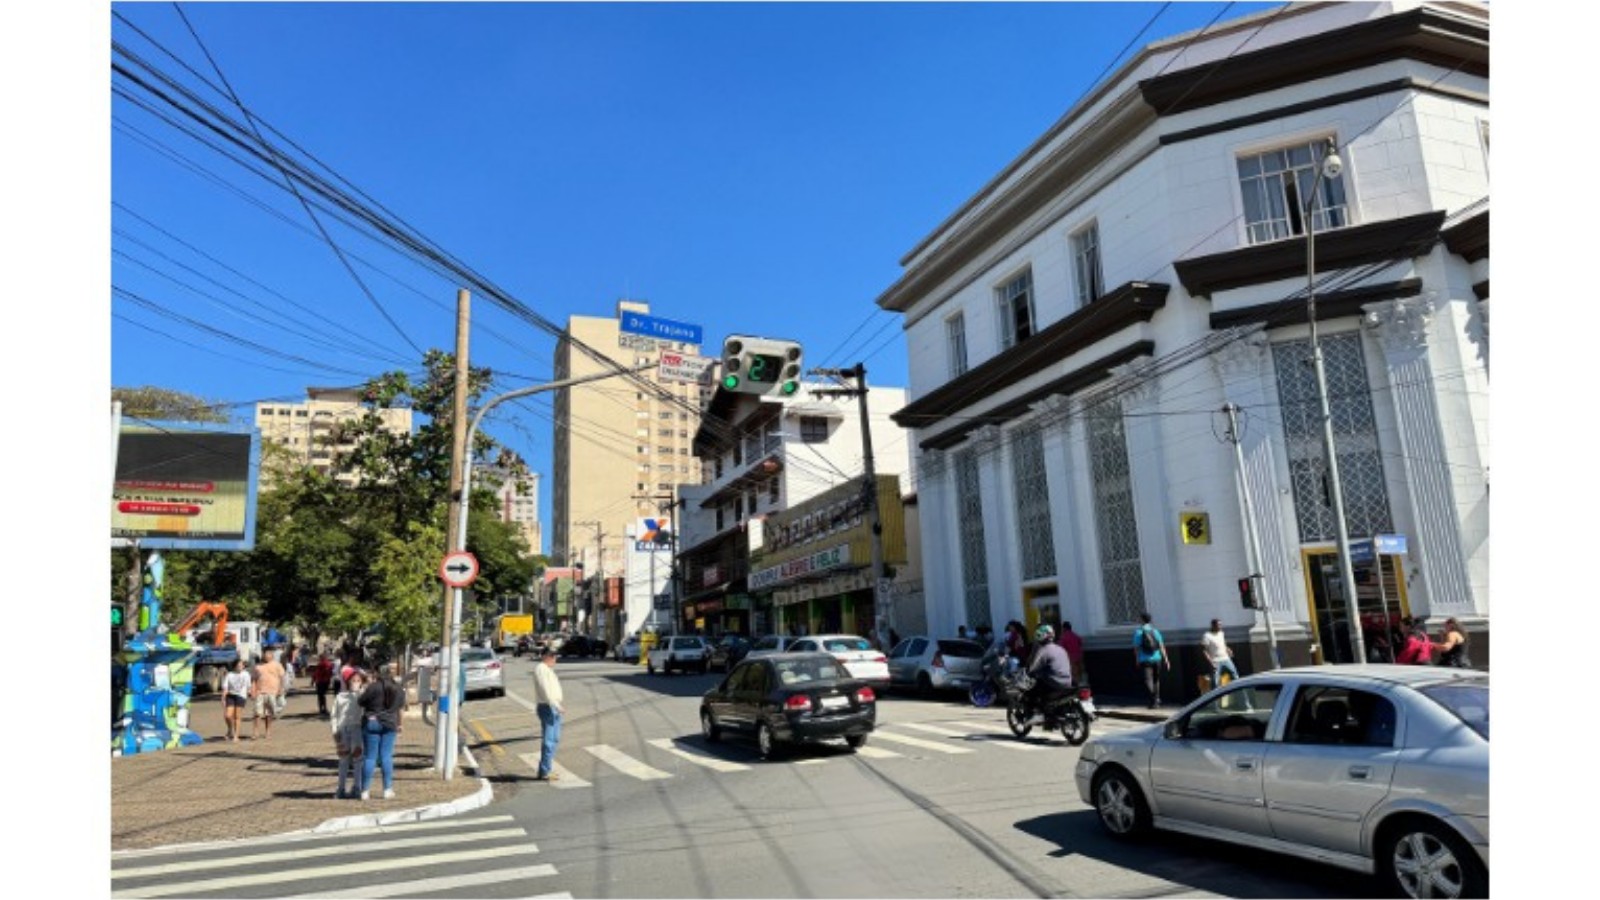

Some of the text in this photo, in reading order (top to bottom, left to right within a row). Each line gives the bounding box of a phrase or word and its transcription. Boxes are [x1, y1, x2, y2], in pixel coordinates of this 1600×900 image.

[630, 318, 695, 338] Dr. Trajano
[749, 354, 766, 381] 2
